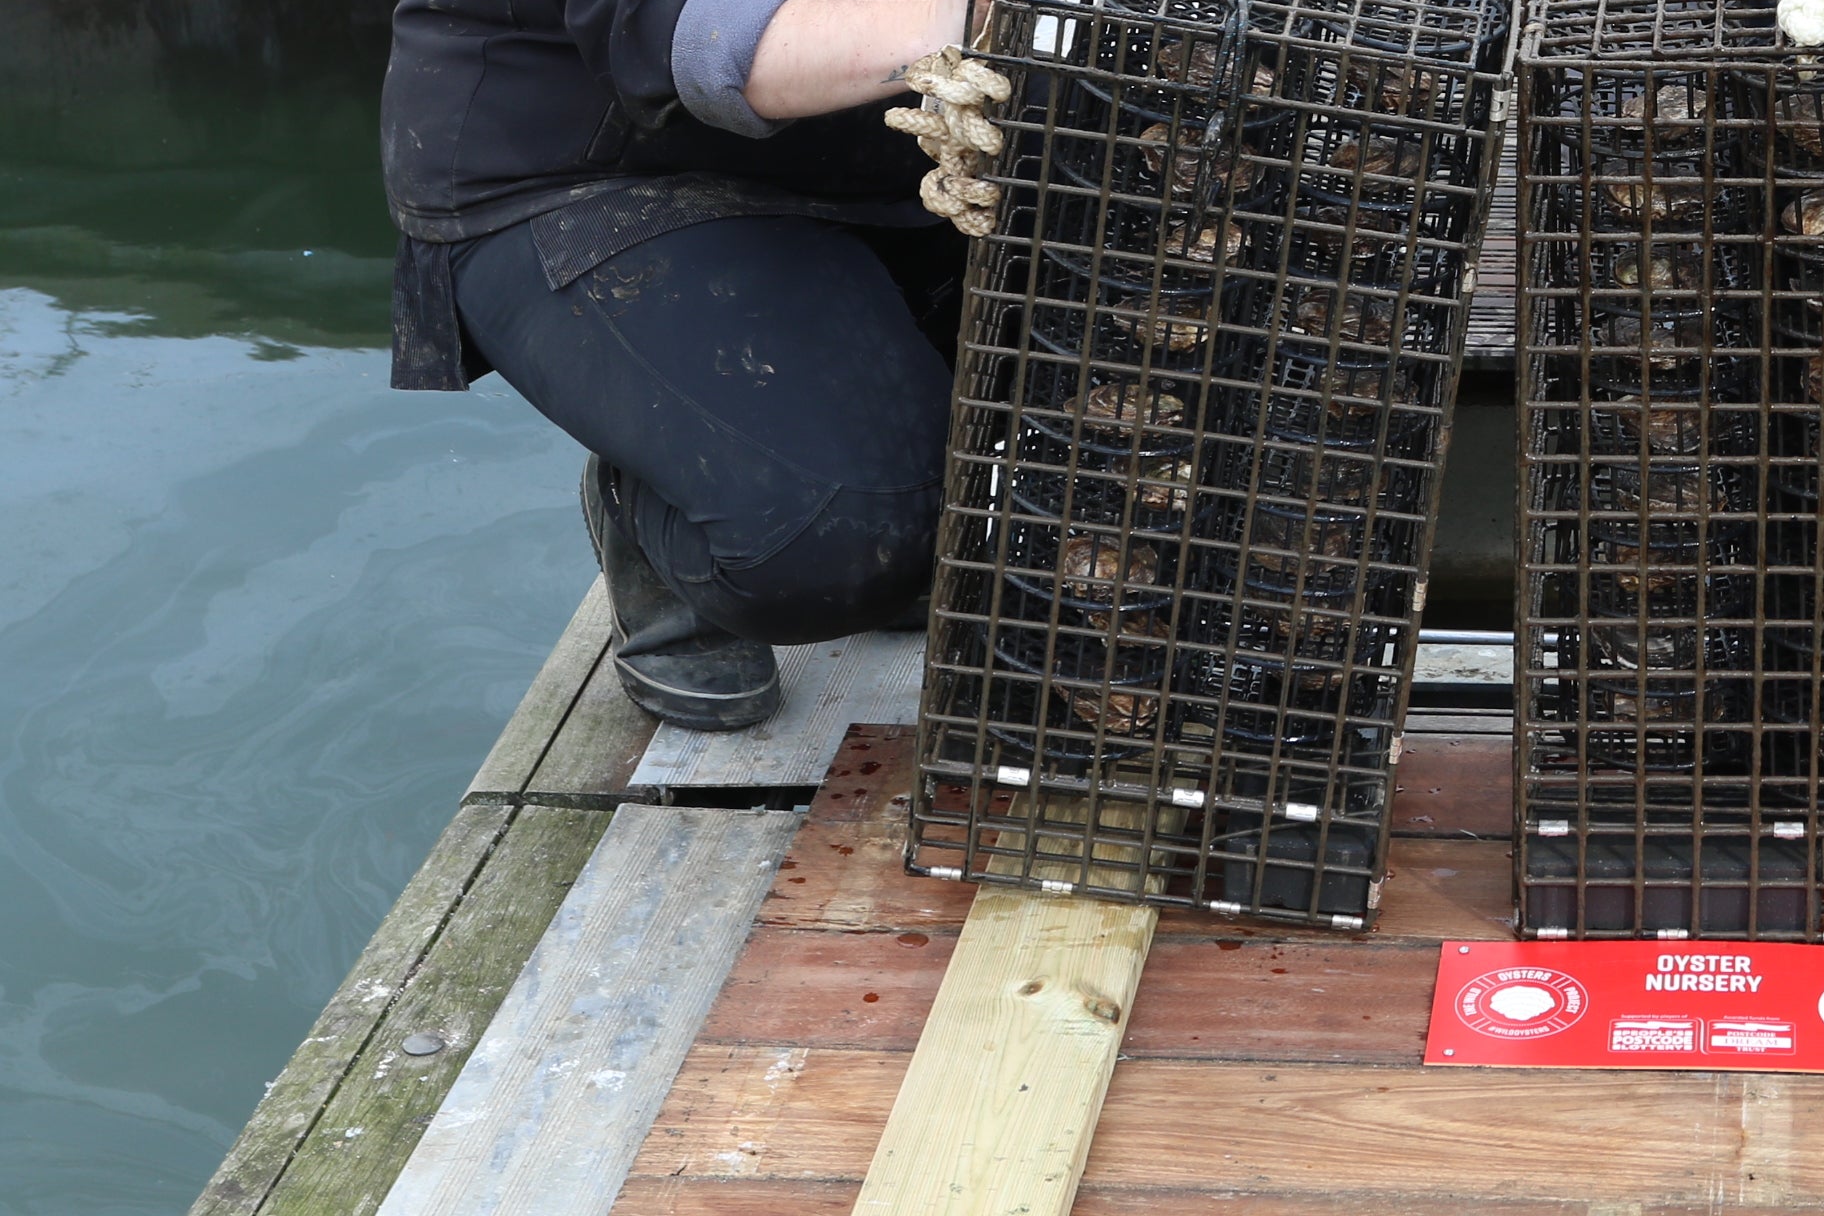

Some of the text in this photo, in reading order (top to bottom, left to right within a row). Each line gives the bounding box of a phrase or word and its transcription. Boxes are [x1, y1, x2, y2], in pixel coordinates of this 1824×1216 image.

[1656, 954, 1751, 973] OYSTER
[1497, 970, 1552, 981] OYSTERS
[1645, 973, 1763, 993] NURSERY
[1564, 986, 1581, 1014] PROJECT
[1488, 1025, 1550, 1036] #WILDOYSTERS
[1612, 1035, 1693, 1046] POSTCODE
[1724, 1037, 1779, 1046] DREAM
